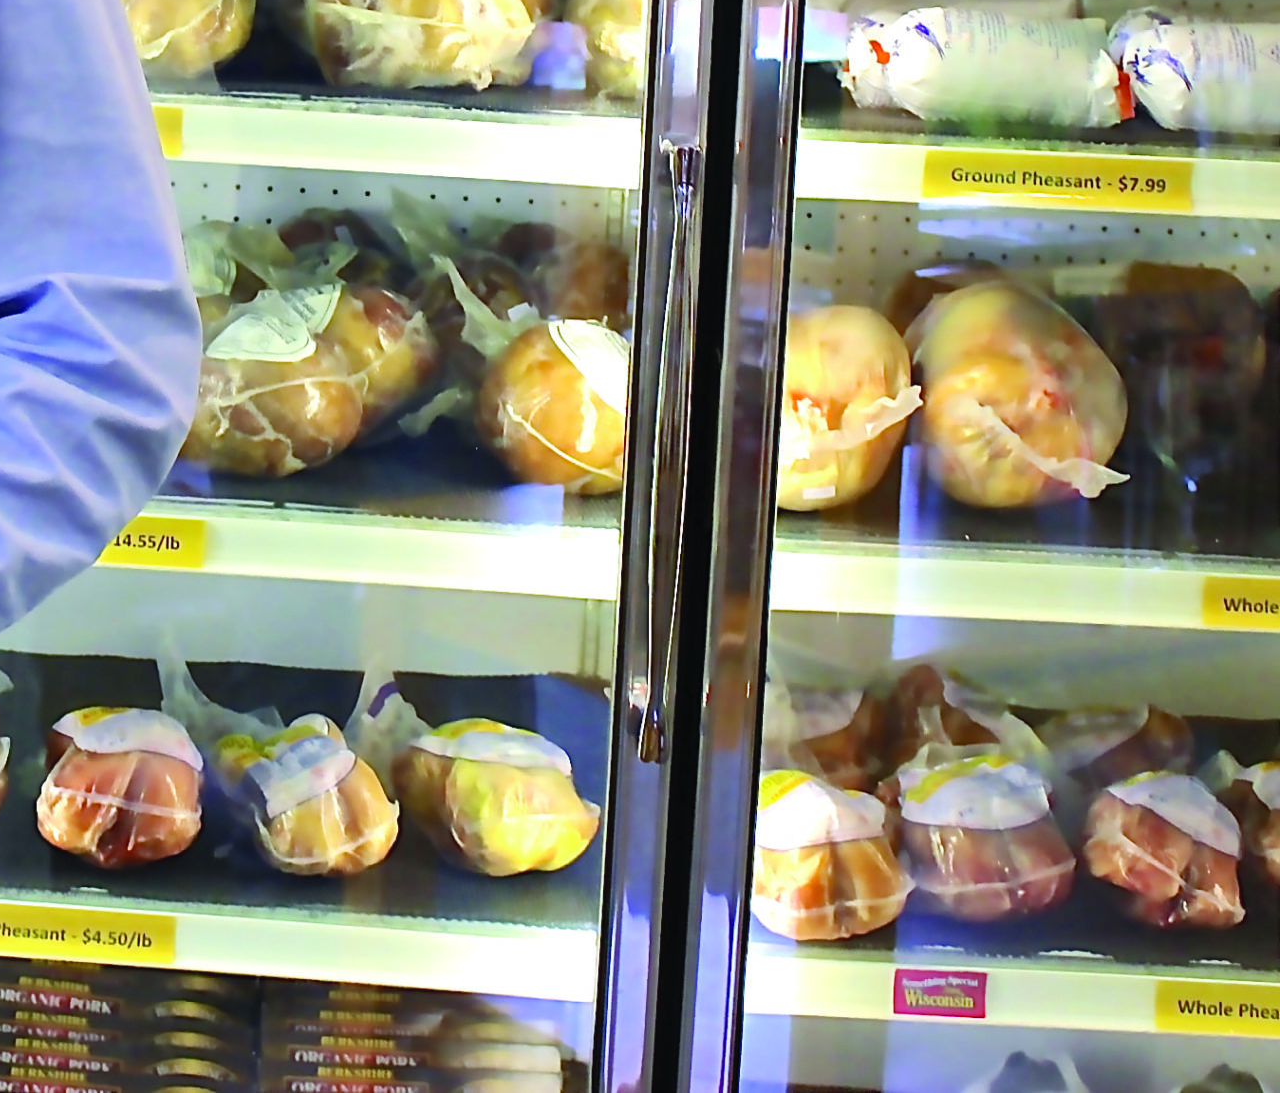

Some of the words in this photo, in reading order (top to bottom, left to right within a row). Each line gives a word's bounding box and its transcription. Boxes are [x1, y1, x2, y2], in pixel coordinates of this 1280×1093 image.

[951, 167, 1016, 184] Ground
[1022, 171, 1102, 189] Pheasant
[1118, 175, 1167, 193] $7.99
[1223, 597, 1280, 615] Whole
[82, 929, 153, 948] $4.50/lb
[70, 996, 112, 1014] PORK
[904, 987, 975, 1009] Wisconsin
[1177, 1000, 1234, 1017] Whole
